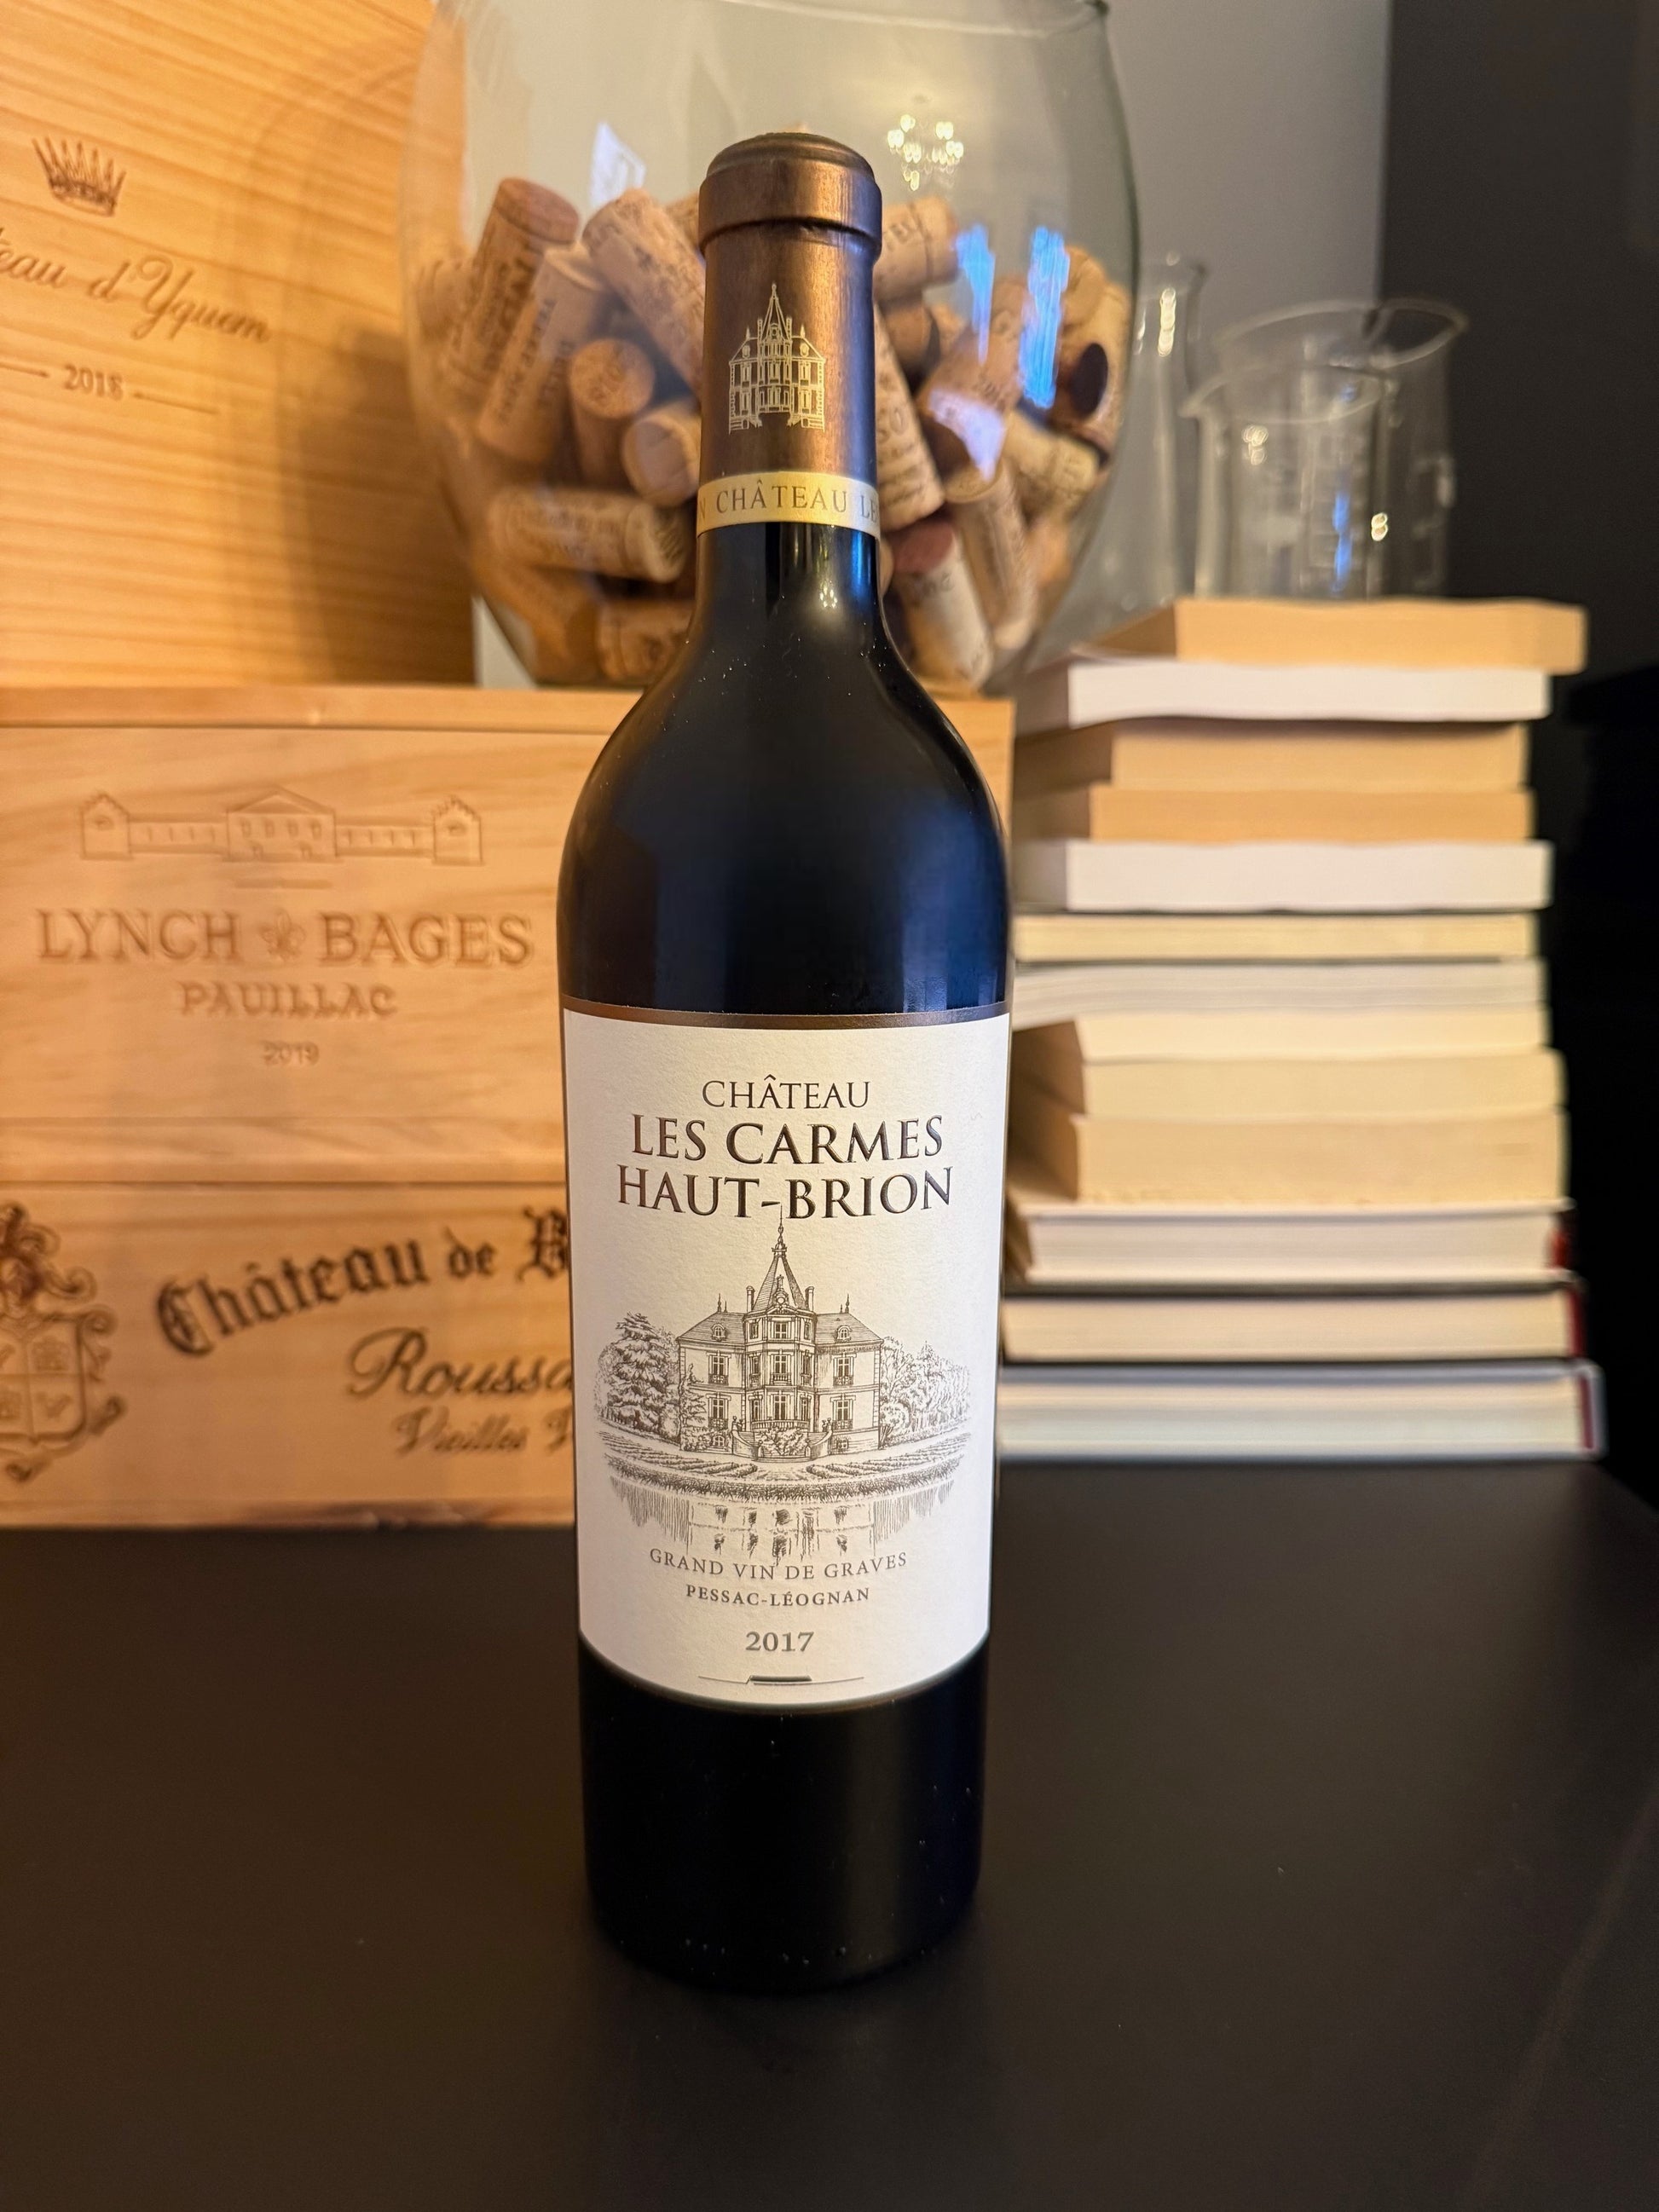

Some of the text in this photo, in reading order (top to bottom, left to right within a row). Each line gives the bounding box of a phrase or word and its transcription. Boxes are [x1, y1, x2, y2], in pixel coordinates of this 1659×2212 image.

[64, 364, 124, 401] 2018
[716, 479, 847, 513] CHÂTEAU
[36, 908, 533, 967] LYNCH BAGES
[178, 981, 397, 1017] PAUILLAC
[261, 1040, 320, 1066] 2019
[702, 1074, 870, 1109] CHÂTEAU
[632, 1113, 943, 1164] LES CARMES
[617, 1164, 953, 1218] HAUT-BRION
[156, 1239, 431, 1356] Château
[441, 1225, 497, 1279] de
[650, 1548, 906, 1580] GRAND VIN DE GRAVES
[686, 1584, 870, 1607] PESSAC-LÉOGNAN
[745, 1631, 814, 1653] 2017
